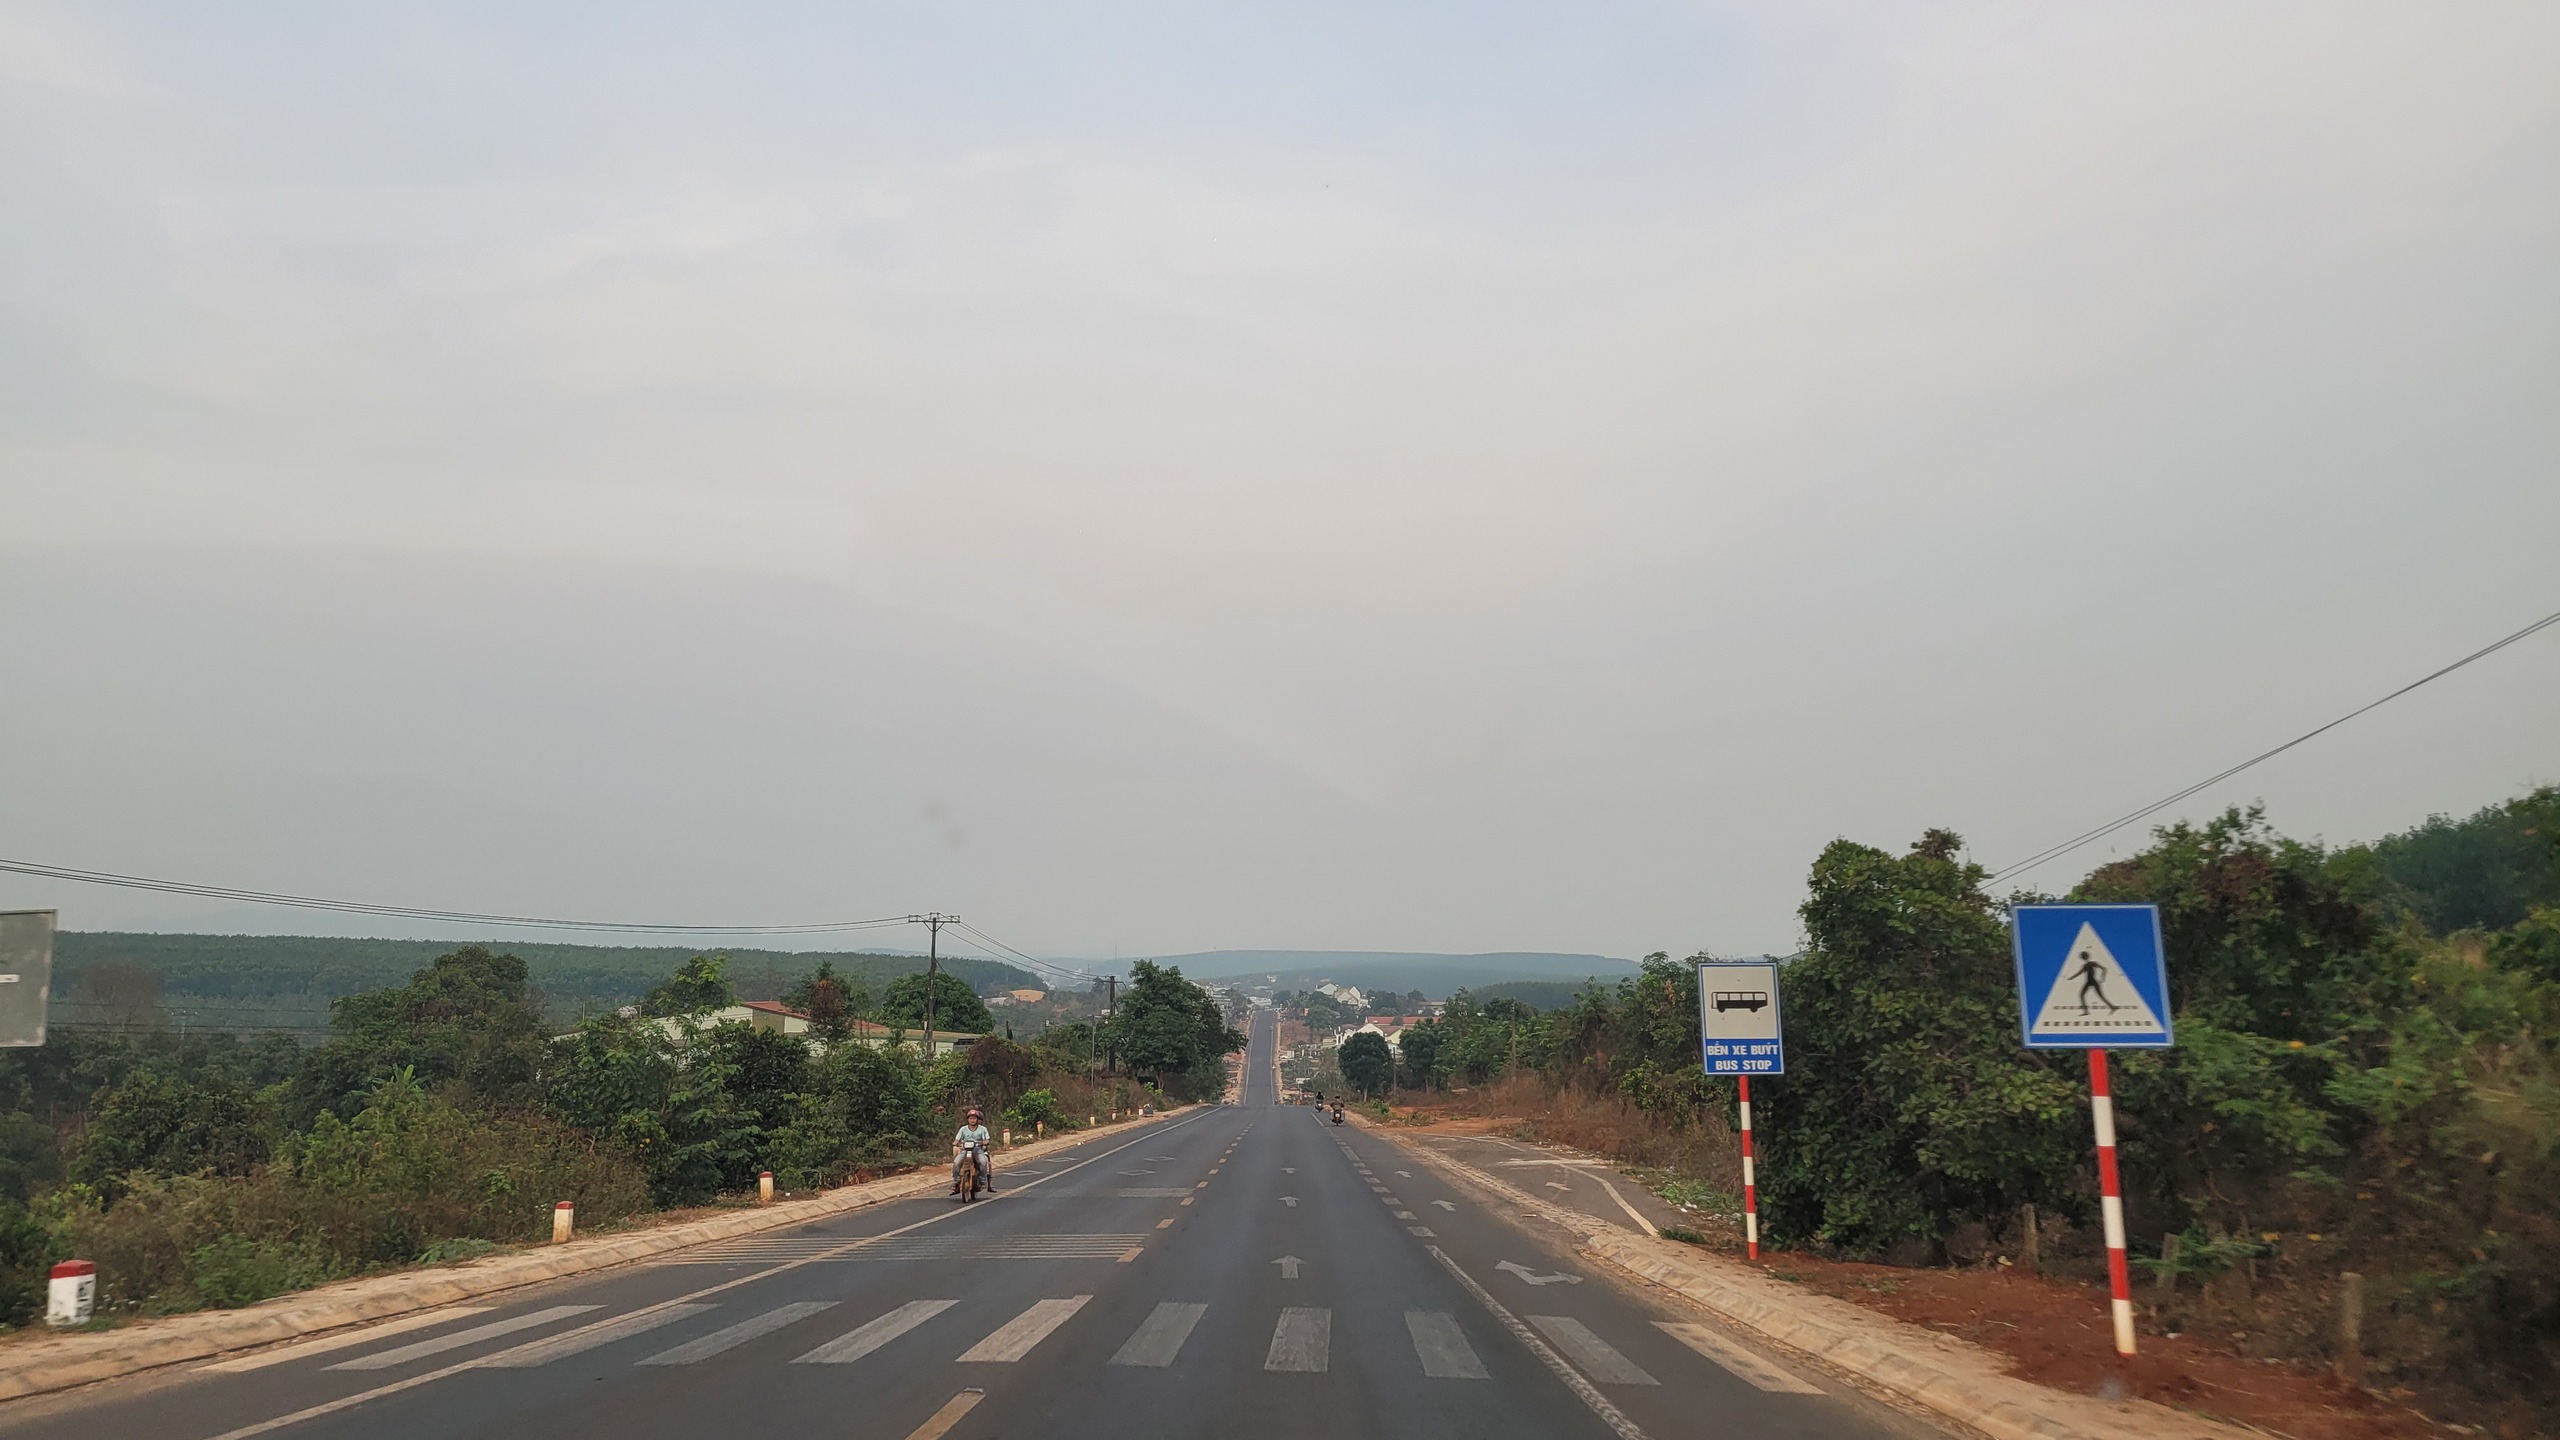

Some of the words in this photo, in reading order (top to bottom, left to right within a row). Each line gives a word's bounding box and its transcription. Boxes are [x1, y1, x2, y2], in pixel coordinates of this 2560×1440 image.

[1708, 1041, 1729, 1056] BẾN
[1732, 1045, 1748, 1055] XE
[1751, 1042, 1778, 1055] BUÝT
[1715, 1060, 1738, 1071] BUS
[1742, 1060, 1772, 1070] STOP
